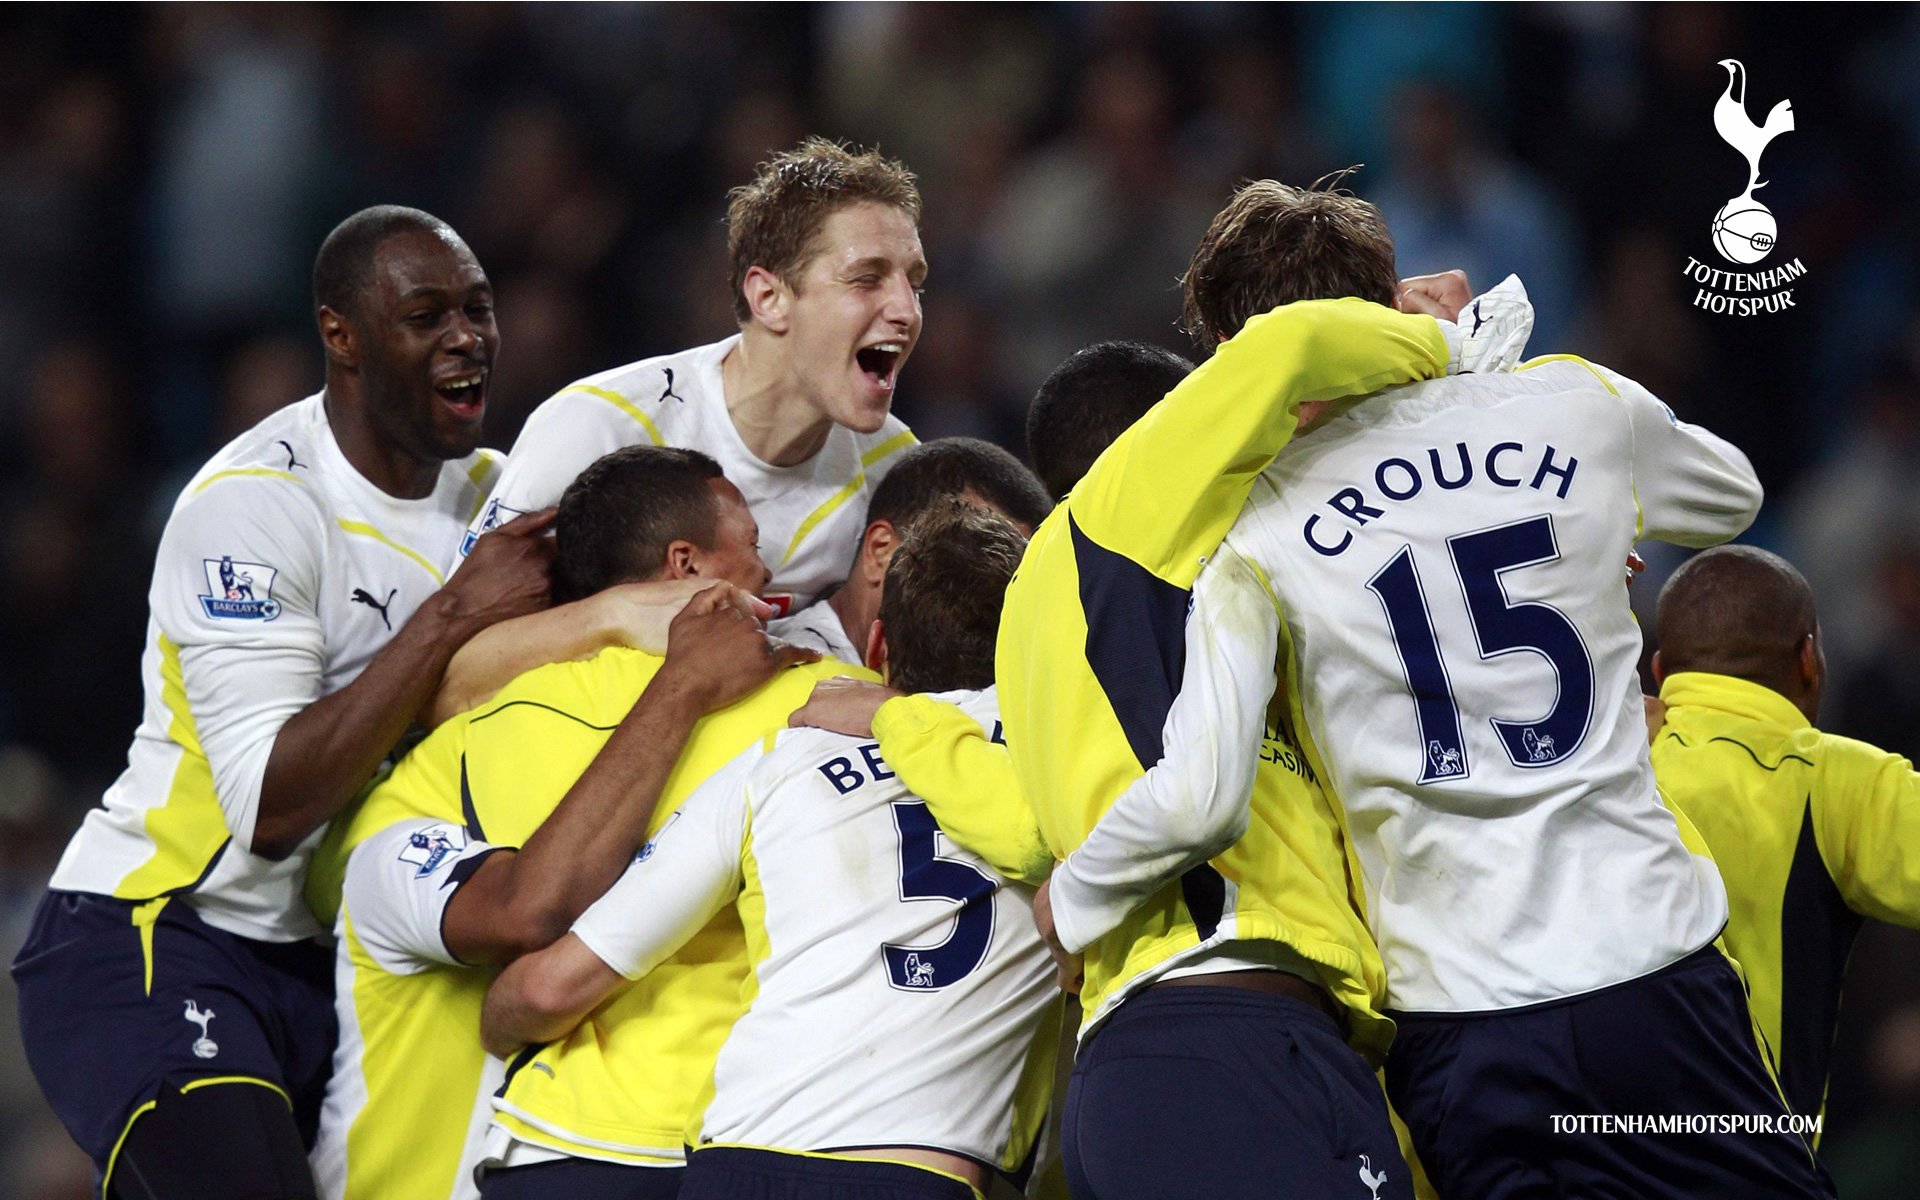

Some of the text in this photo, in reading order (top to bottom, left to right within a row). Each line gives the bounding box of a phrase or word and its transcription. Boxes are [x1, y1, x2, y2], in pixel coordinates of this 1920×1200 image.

[1303, 442, 1579, 556] CROUCH
[213, 602, 258, 613] BARCLAYS
[1365, 513, 1595, 785] 15
[818, 743, 896, 795] BE
[881, 800, 999, 992] 5
